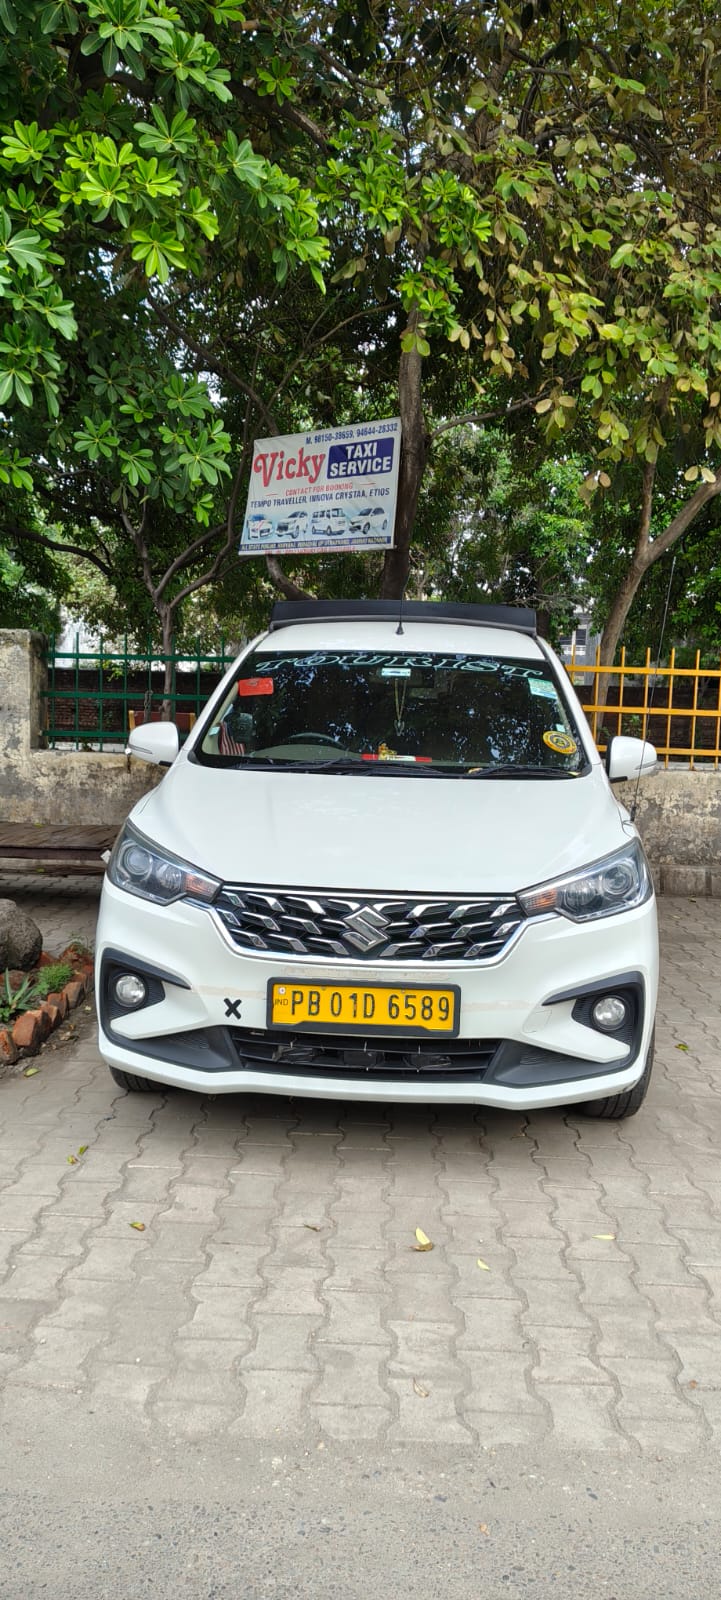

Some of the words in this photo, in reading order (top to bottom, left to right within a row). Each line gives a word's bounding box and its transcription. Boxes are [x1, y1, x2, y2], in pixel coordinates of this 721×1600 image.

[346, 442, 378, 460] TAXI
[253, 447, 326, 487] Vicky
[329, 456, 392, 477] SERVICE
[250, 500, 271, 508] TEMPO
[310, 493, 333, 502] INNOVA
[369, 488, 390, 497] ETIOS
[285, 487, 312, 496] CONTACT
[326, 482, 353, 491] BOOKING
[256, 655, 543, 678] TOURIST
[274, 998, 288, 1006] IND
[291, 990, 320, 1016] PB
[388, 994, 449, 1021] 6589
